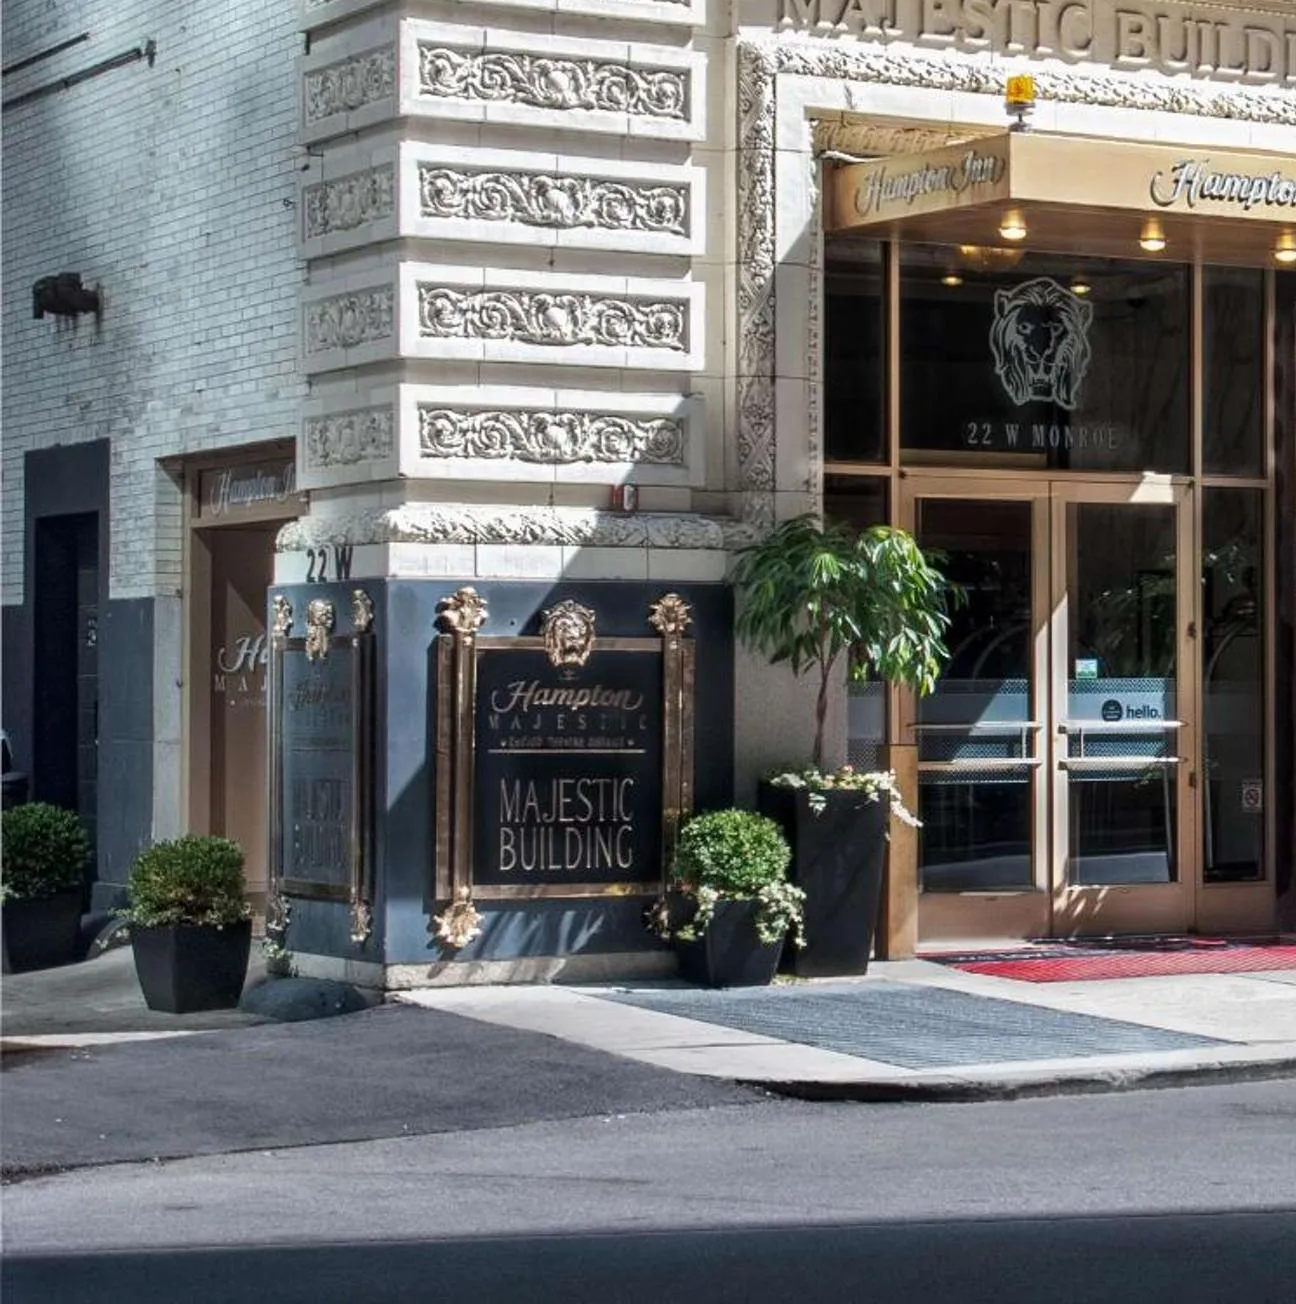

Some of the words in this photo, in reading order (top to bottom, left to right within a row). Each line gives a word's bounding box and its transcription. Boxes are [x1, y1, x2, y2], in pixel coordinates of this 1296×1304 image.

[854, 161, 956, 218] Hampton
[953, 149, 1006, 196] Inn
[967, 421, 992, 445] 22
[1005, 423, 1020, 446] W
[1032, 423, 1118, 450] MONROE
[306, 548, 327, 584] 22
[334, 544, 354, 581] W
[491, 680, 644, 713] Hampton
[488, 714, 649, 731] MAJESTIC
[500, 777, 635, 824] MAJESTIC
[500, 825, 634, 872] BUILDING
